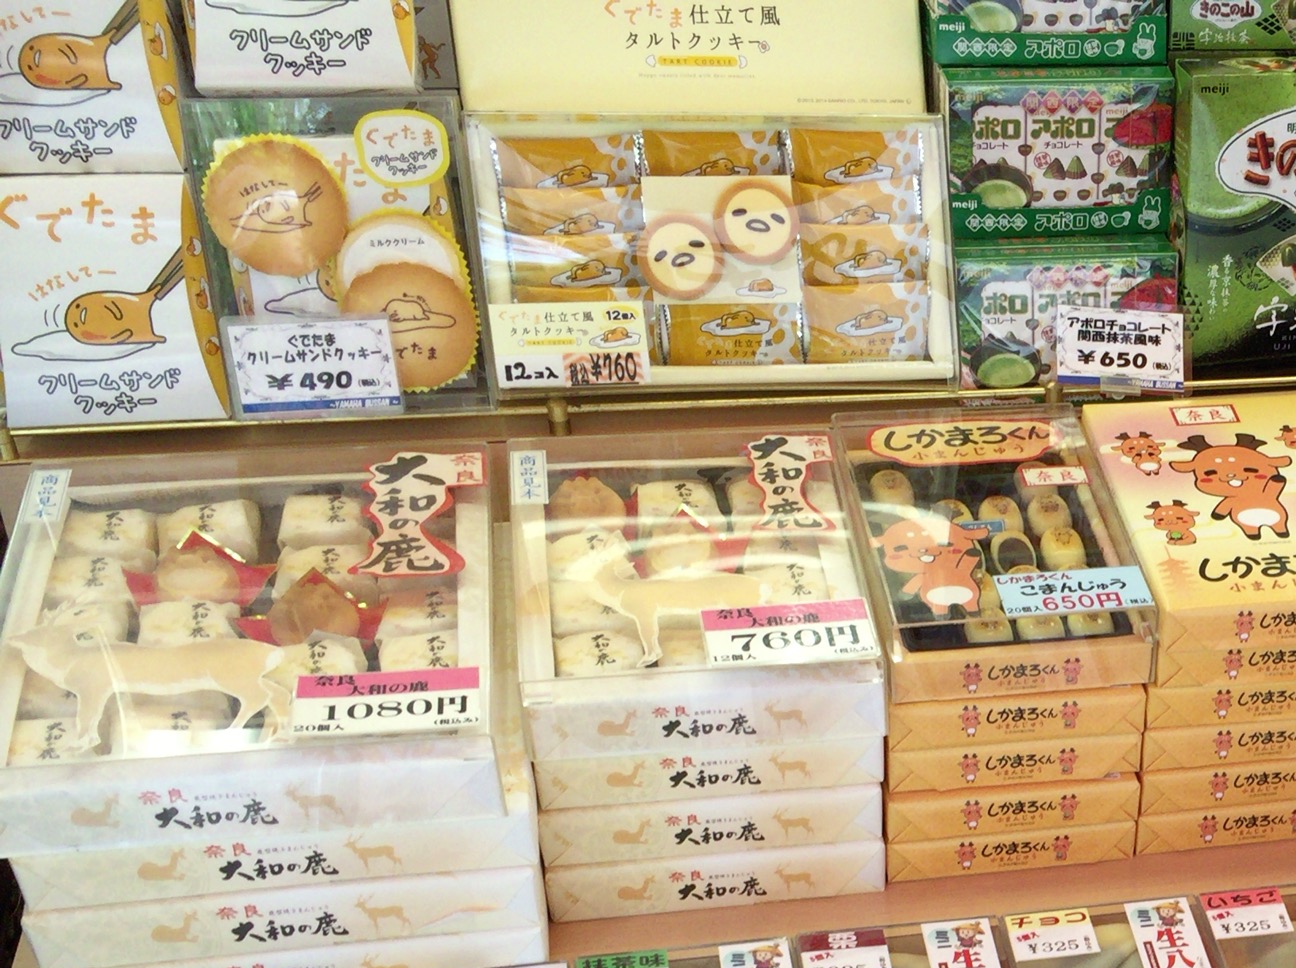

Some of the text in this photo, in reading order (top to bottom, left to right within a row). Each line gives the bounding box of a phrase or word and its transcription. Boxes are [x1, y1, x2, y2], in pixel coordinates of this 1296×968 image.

[939, 23, 966, 33] meiji
[229, 28, 372, 54] クリームサンド
[625, 31, 761, 51] タルトクッキー
[1024, 38, 1082, 59] アポロ
[263, 52, 347, 77] クッキー
[1201, 83, 1230, 95] meiji
[365, 124, 436, 149] ぐでたま
[1030, 116, 1096, 141] アポロ
[29, 140, 113, 164] クッキー
[1044, 141, 1083, 151] チョコレート
[370, 148, 438, 167] クリームサンド
[387, 163, 428, 177] クッキー
[952, 202, 978, 212] meiji
[1034, 212, 1089, 232] アポロ
[369, 237, 426, 248] ミルククリーム
[510, 326, 582, 337] タルトクッキー
[1067, 317, 1172, 334] アポロチョコレート
[287, 334, 336, 347] ぐでたま
[1077, 330, 1162, 347] 関西抹茶風味
[1273, 342, 1292, 351] UJI
[246, 348, 383, 365] クリームサンドクッキー
[1078, 349, 1148, 369] ¥650
[38, 368, 182, 393] クリームサンド
[267, 370, 353, 391] ¥490
[74, 392, 158, 417] クッキー
[884, 425, 1049, 451] しかまろくん
[913, 444, 1025, 461] 小まんじゅう
[360, 455, 446, 573] 大和の鹿
[997, 573, 1072, 584] しかまろくん
[1020, 579, 1127, 596] こまんじゅう
[1043, 592, 1123, 611] 650円
[731, 624, 861, 652] 760円
[987, 661, 1060, 681] しかまろくん
[315, 674, 355, 688] 奈良
[346, 679, 430, 696] 大和の鹿
[321, 696, 469, 722] 1080円
[138, 788, 188, 805] 奈良
[155, 798, 279, 830] 大和の鹿
[203, 842, 252, 859] 奈良
[218, 851, 340, 882] 大和の鹿
[1207, 889, 1278, 909] いちご
[231, 912, 350, 943] 大和の鹿
[1011, 910, 1088, 929] チョコ
[1220, 919, 1271, 934] ¥325
[1028, 939, 1080, 954] ¥325
